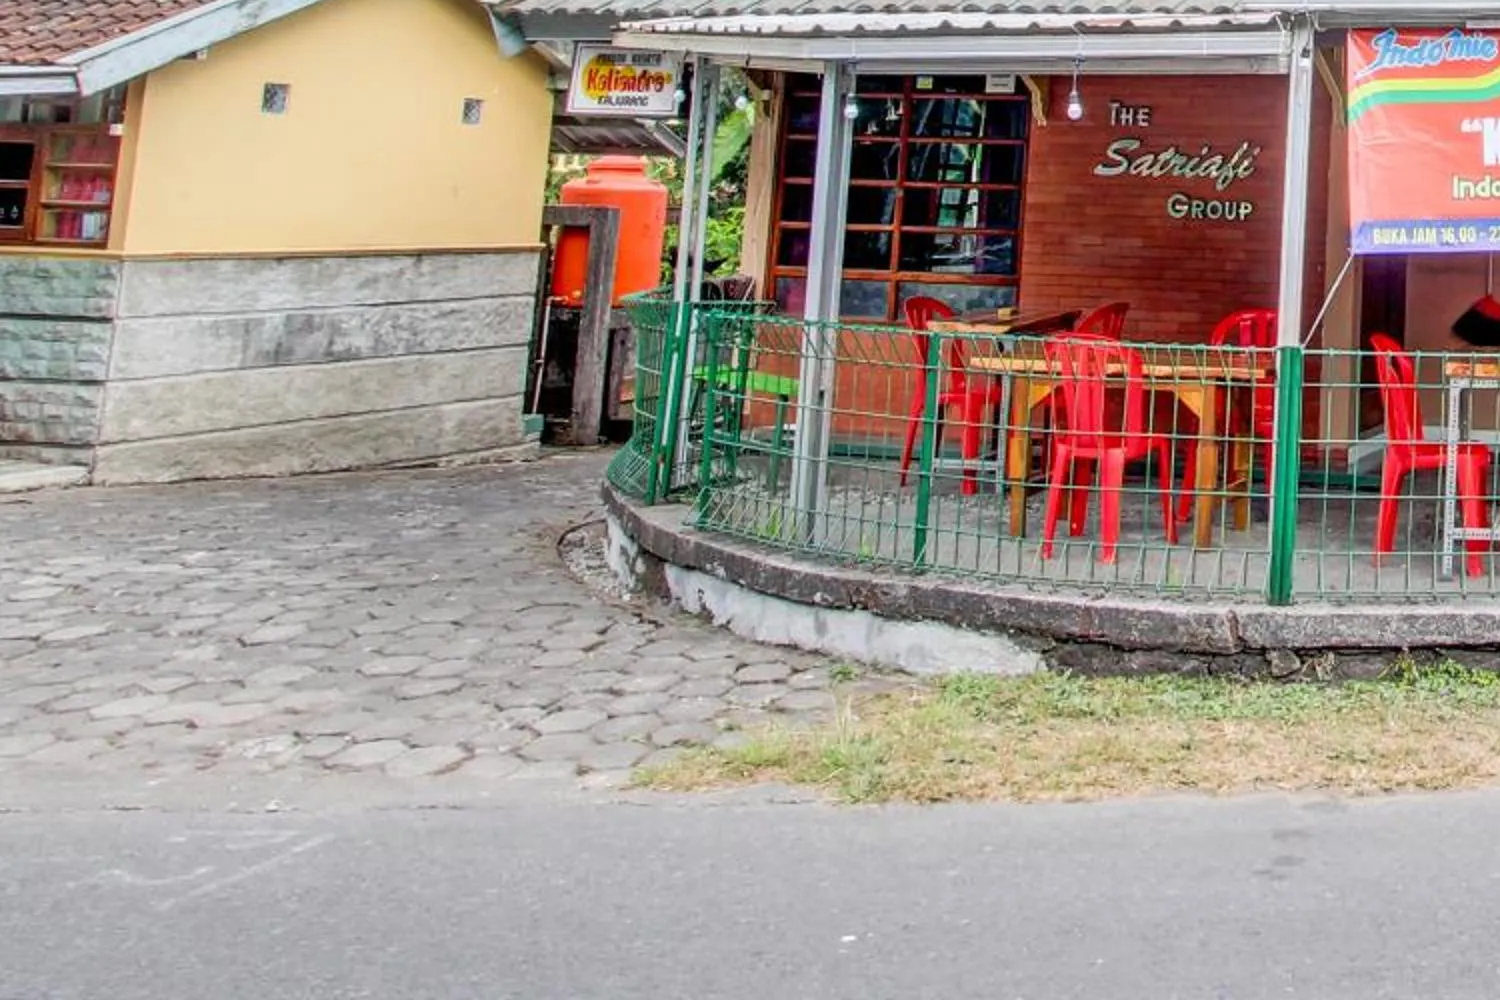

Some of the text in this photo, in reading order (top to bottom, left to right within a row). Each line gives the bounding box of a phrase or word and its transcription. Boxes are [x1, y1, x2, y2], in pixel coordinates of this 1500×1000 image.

[1354, 29, 1498, 79] Indomie
[1109, 102, 1150, 127] THE
[1166, 193, 1253, 221] GROUP
[1373, 227, 1407, 245] BUKA
[1411, 226, 1437, 245] JAM
